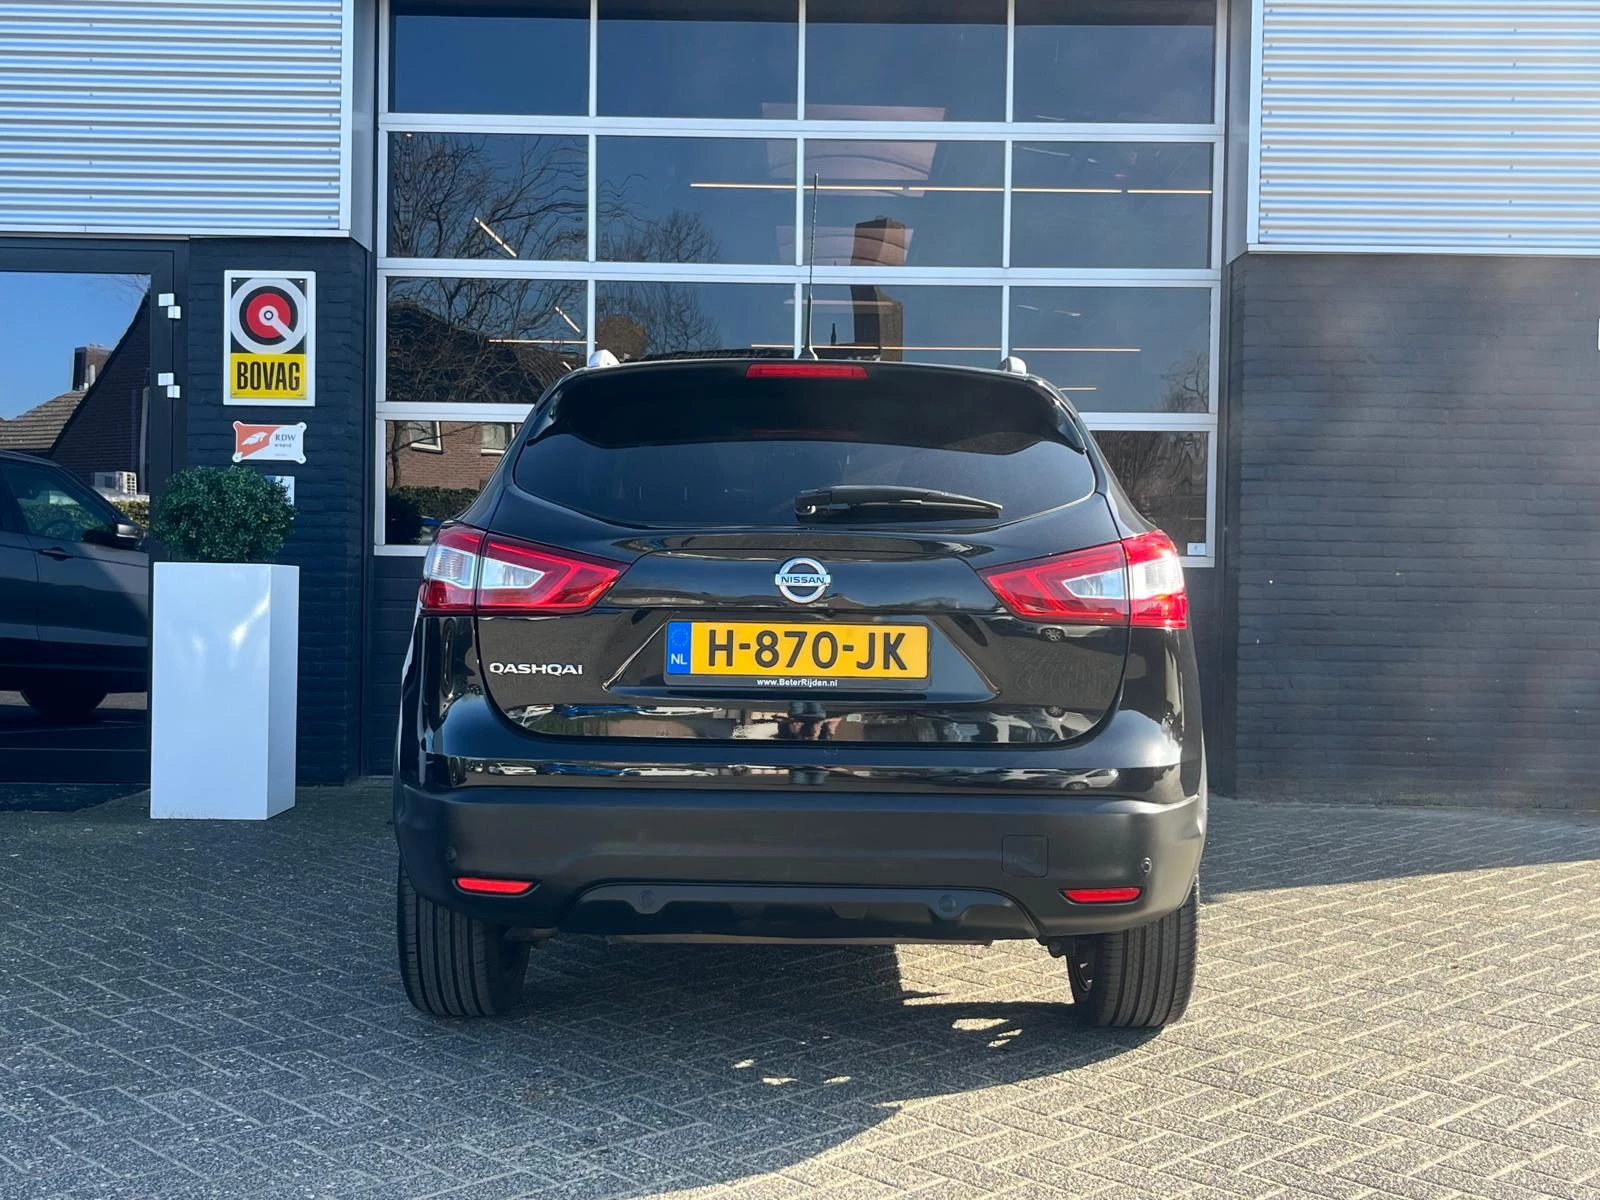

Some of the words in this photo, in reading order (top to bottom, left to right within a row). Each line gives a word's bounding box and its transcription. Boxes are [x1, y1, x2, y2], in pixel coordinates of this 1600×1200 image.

[237, 361, 300, 391] BOVAG
[781, 576, 825, 584] NISSAN
[708, 629, 908, 670] H-870-JK
[670, 654, 688, 665] NL
[489, 662, 583, 676] QASHQAI
[756, 678, 838, 688] www.BeterRijden.nl
